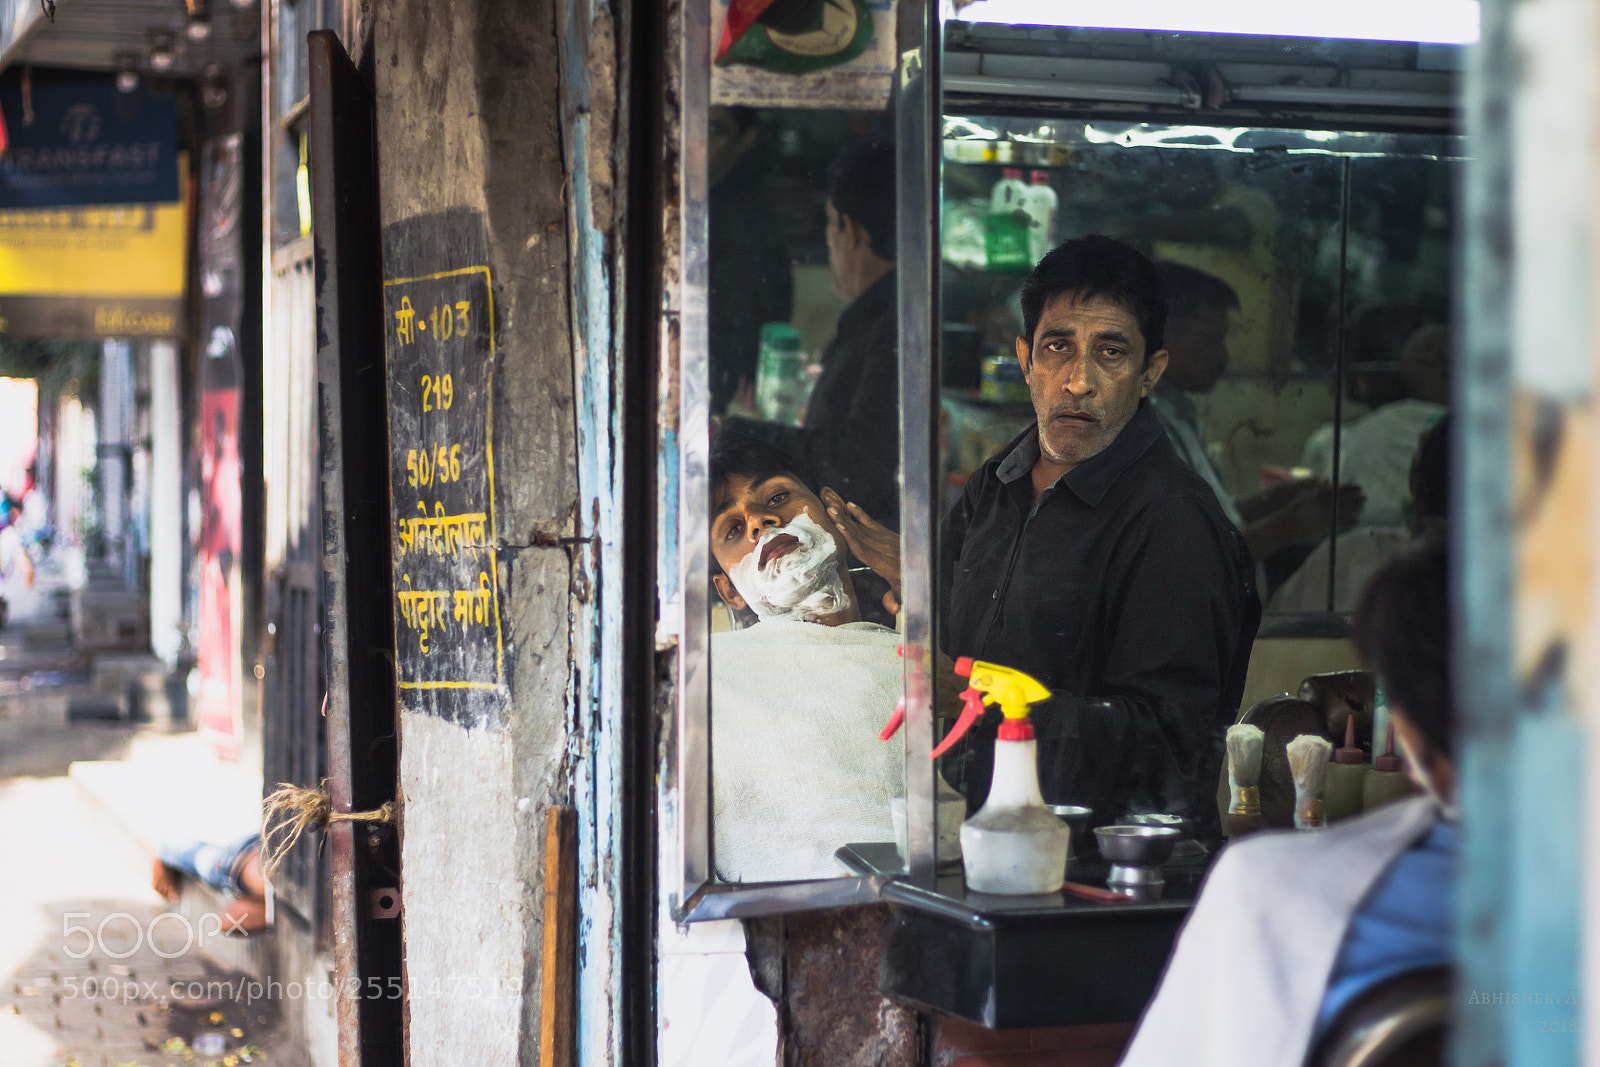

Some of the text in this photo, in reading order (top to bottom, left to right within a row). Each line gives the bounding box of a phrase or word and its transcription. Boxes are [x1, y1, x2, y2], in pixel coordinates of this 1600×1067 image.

[421, 373, 453, 412] 219
[407, 442, 461, 490] 50/56
[454, 571, 491, 627] मार्ग
